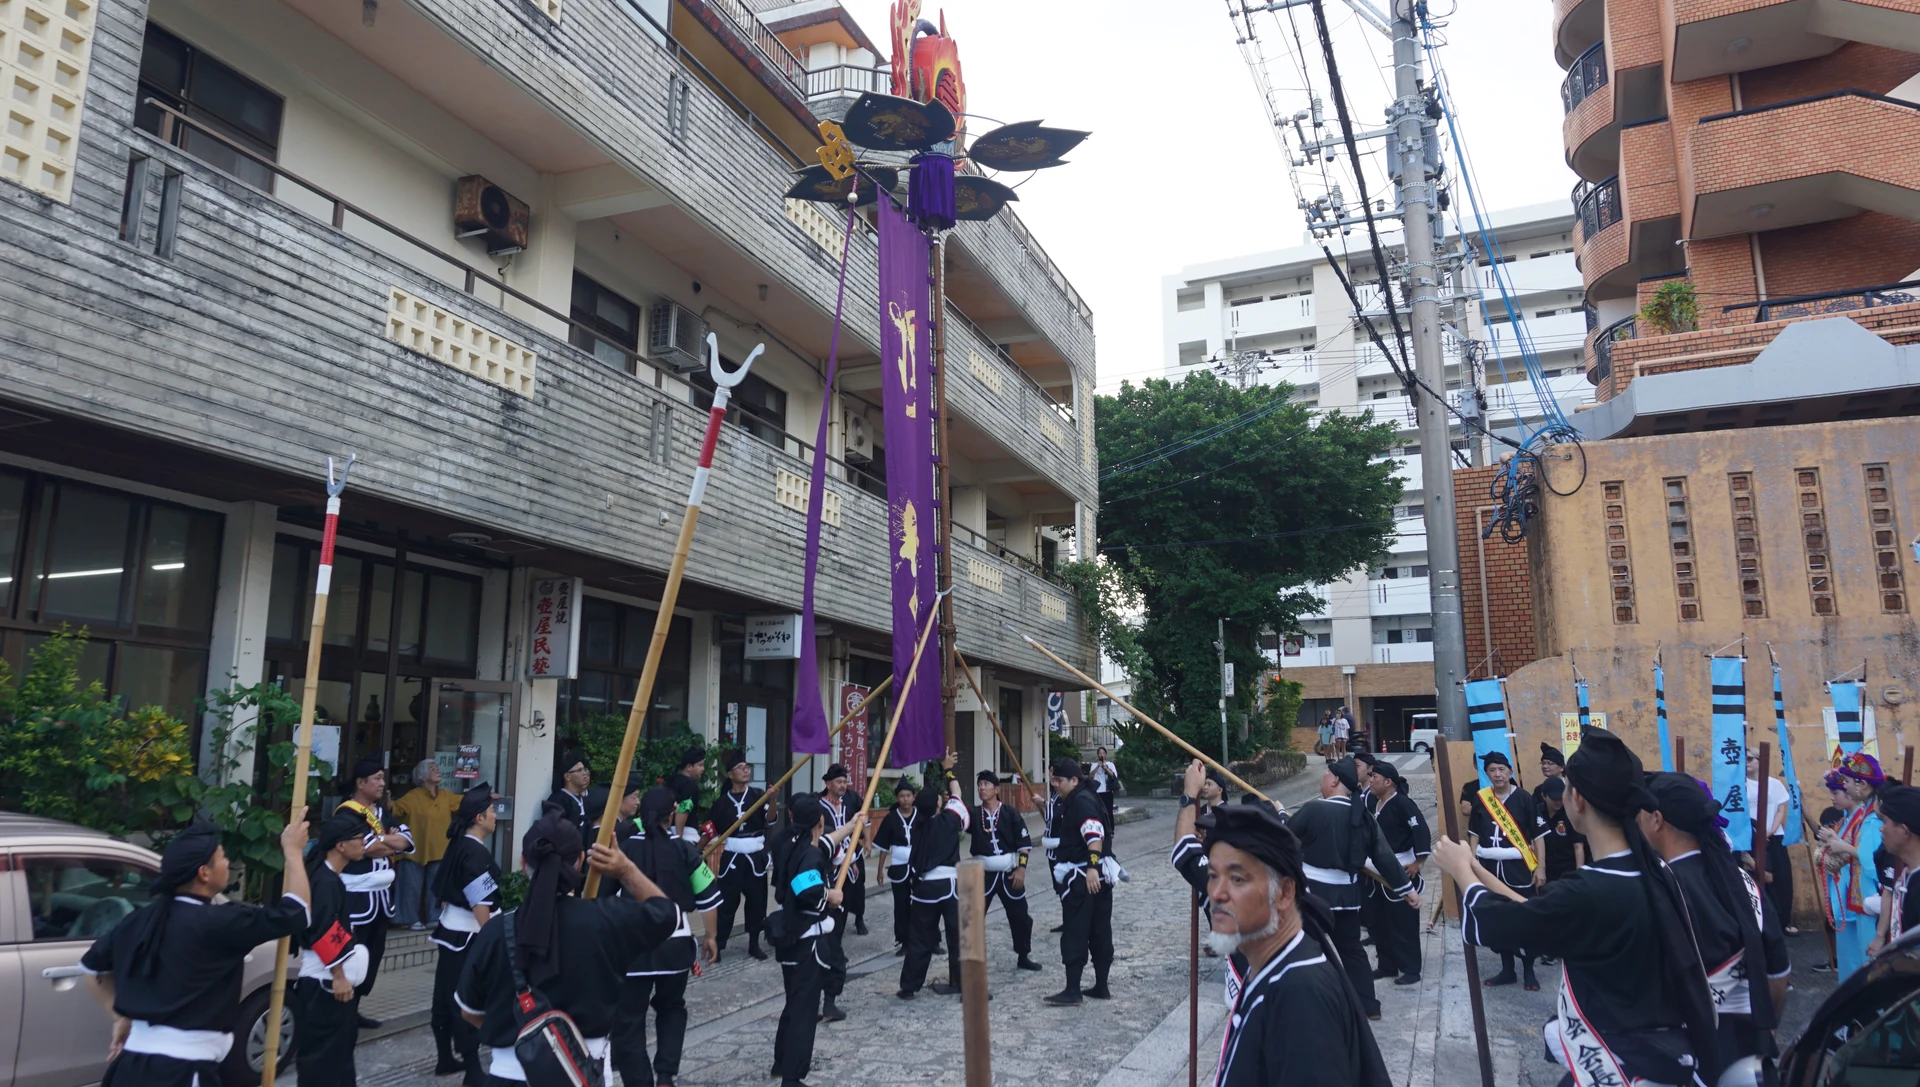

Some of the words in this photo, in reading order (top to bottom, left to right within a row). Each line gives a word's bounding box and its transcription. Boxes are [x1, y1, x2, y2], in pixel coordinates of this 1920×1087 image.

[555, 582, 569, 624] 壺屋焼
[1720, 737, 1745, 813] 壺屋
